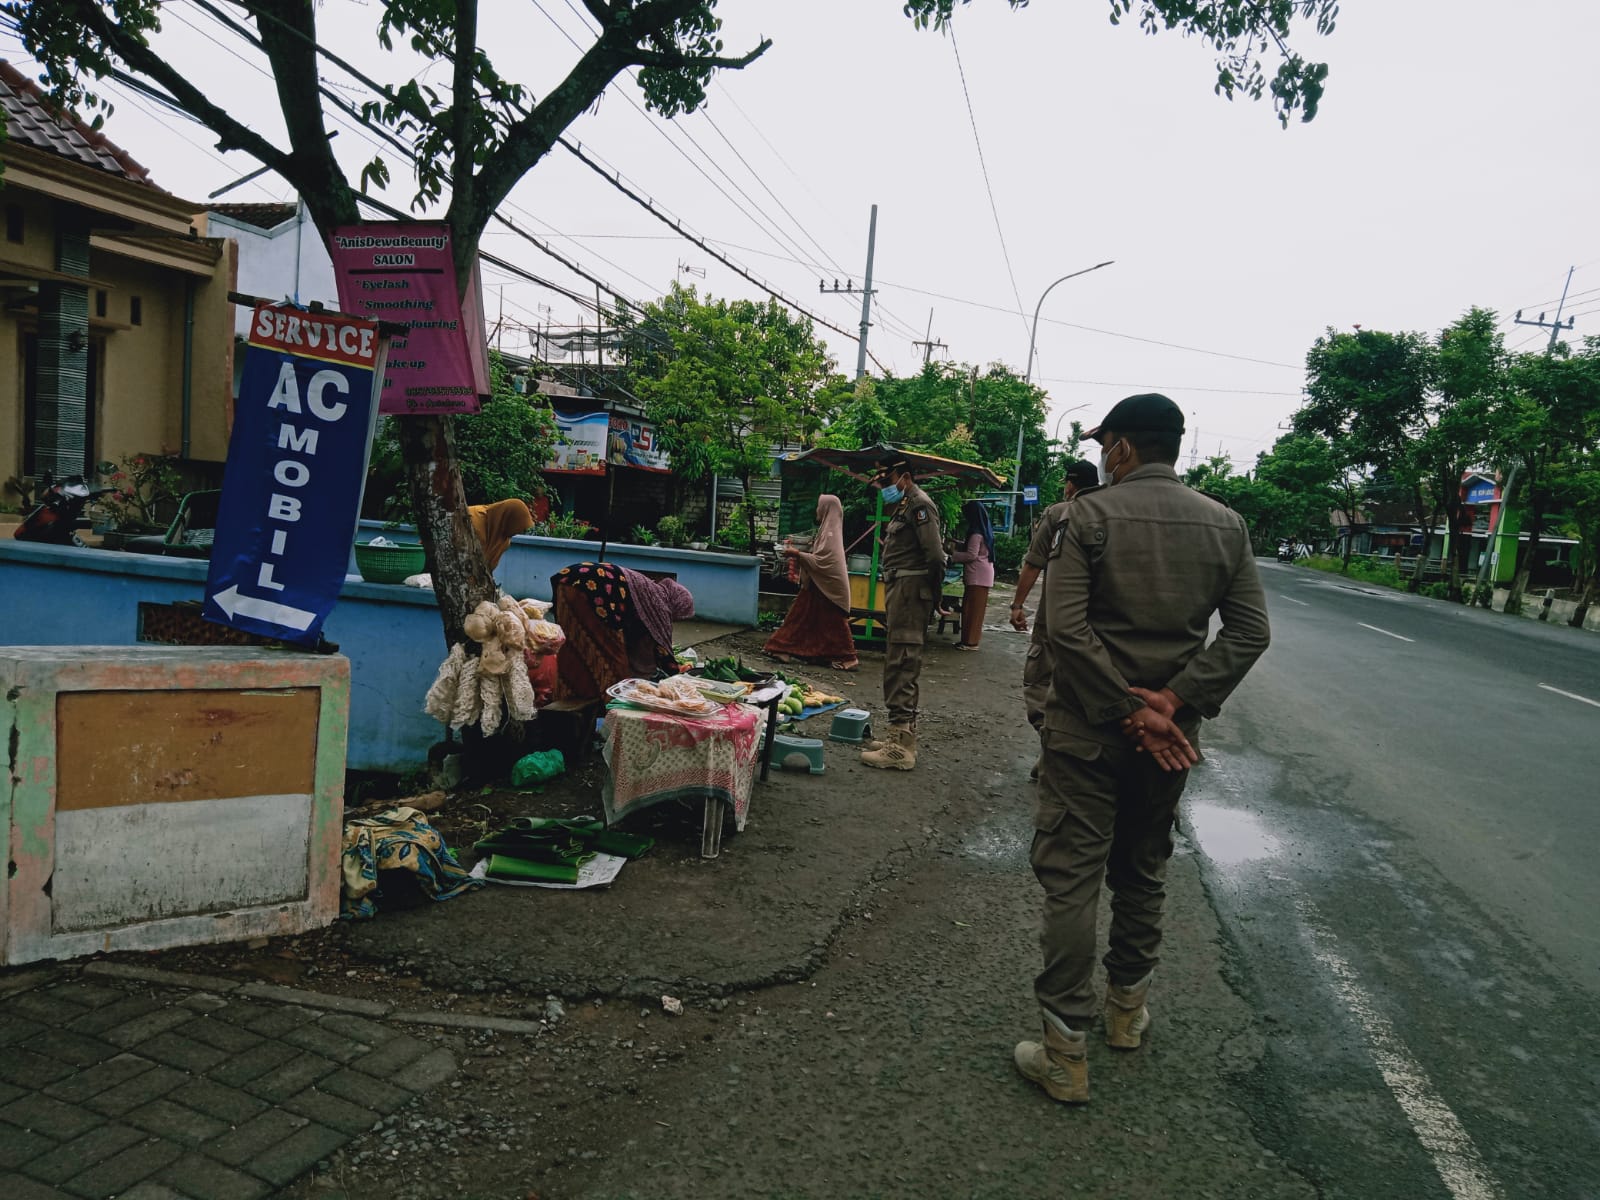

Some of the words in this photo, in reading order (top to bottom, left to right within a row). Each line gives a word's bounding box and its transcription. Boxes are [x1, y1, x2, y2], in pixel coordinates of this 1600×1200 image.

[373, 254, 415, 266] SALON
[361, 279, 409, 291] Eyelash
[364, 300, 434, 311] Smoothing
[400, 319, 458, 330] olouring
[256, 309, 375, 358] SERVICE
[267, 361, 350, 422] AC
[257, 423, 319, 592] MOBIL
